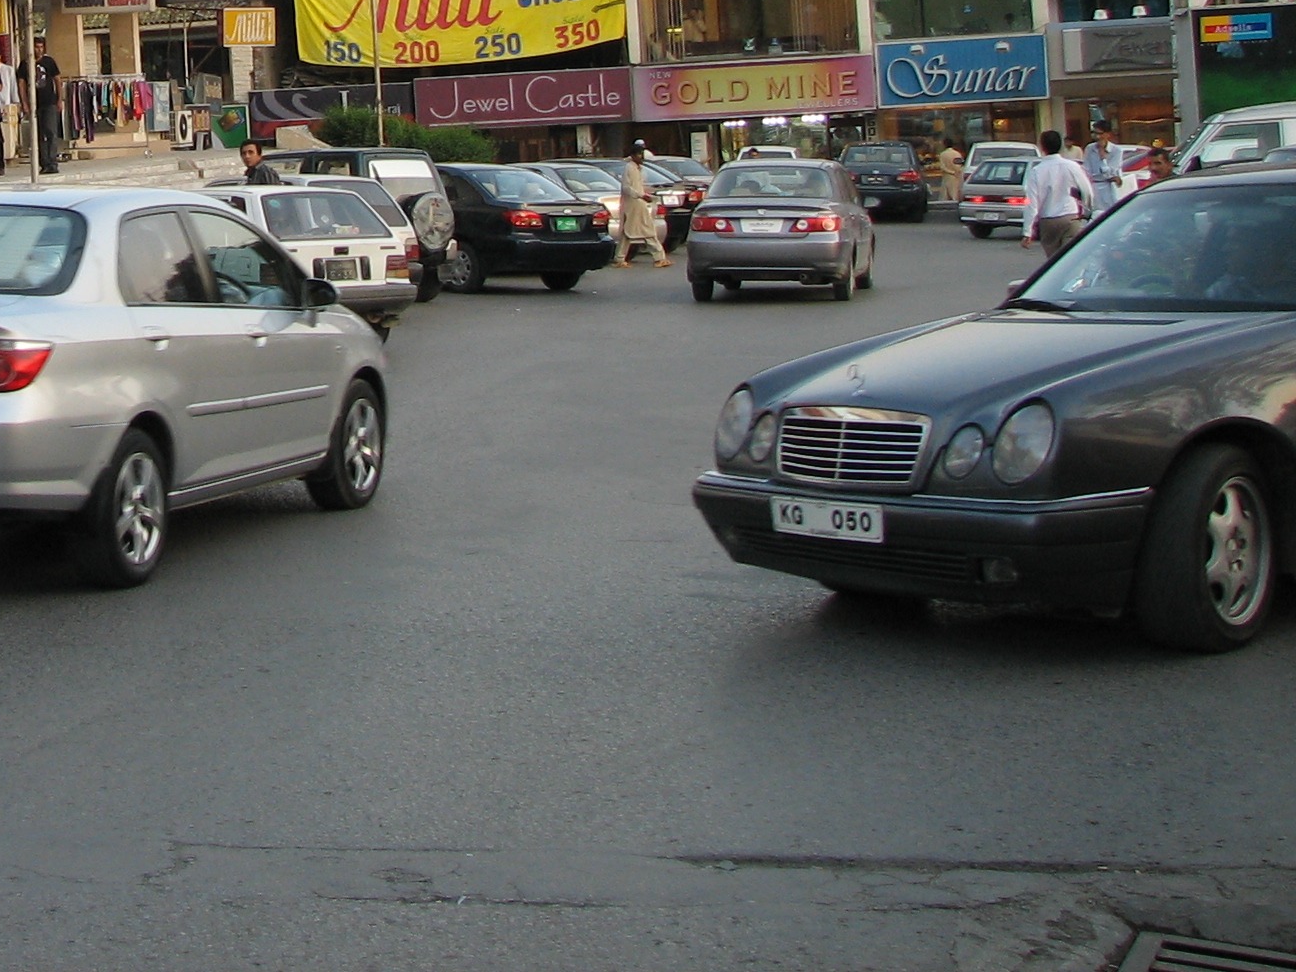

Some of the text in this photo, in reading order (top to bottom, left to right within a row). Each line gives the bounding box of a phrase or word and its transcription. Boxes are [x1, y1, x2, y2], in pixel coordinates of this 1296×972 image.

[474, 32, 522, 59] 250
[554, 18, 601, 48] 350
[324, 39, 362, 64] 150
[393, 39, 440, 65] 200
[649, 70, 672, 79] NEW
[651, 71, 858, 106] GOLD MINE
[886, 54, 1037, 98] Sunar
[429, 74, 621, 120] Jewel Castle
[779, 504, 872, 532] KG 050
